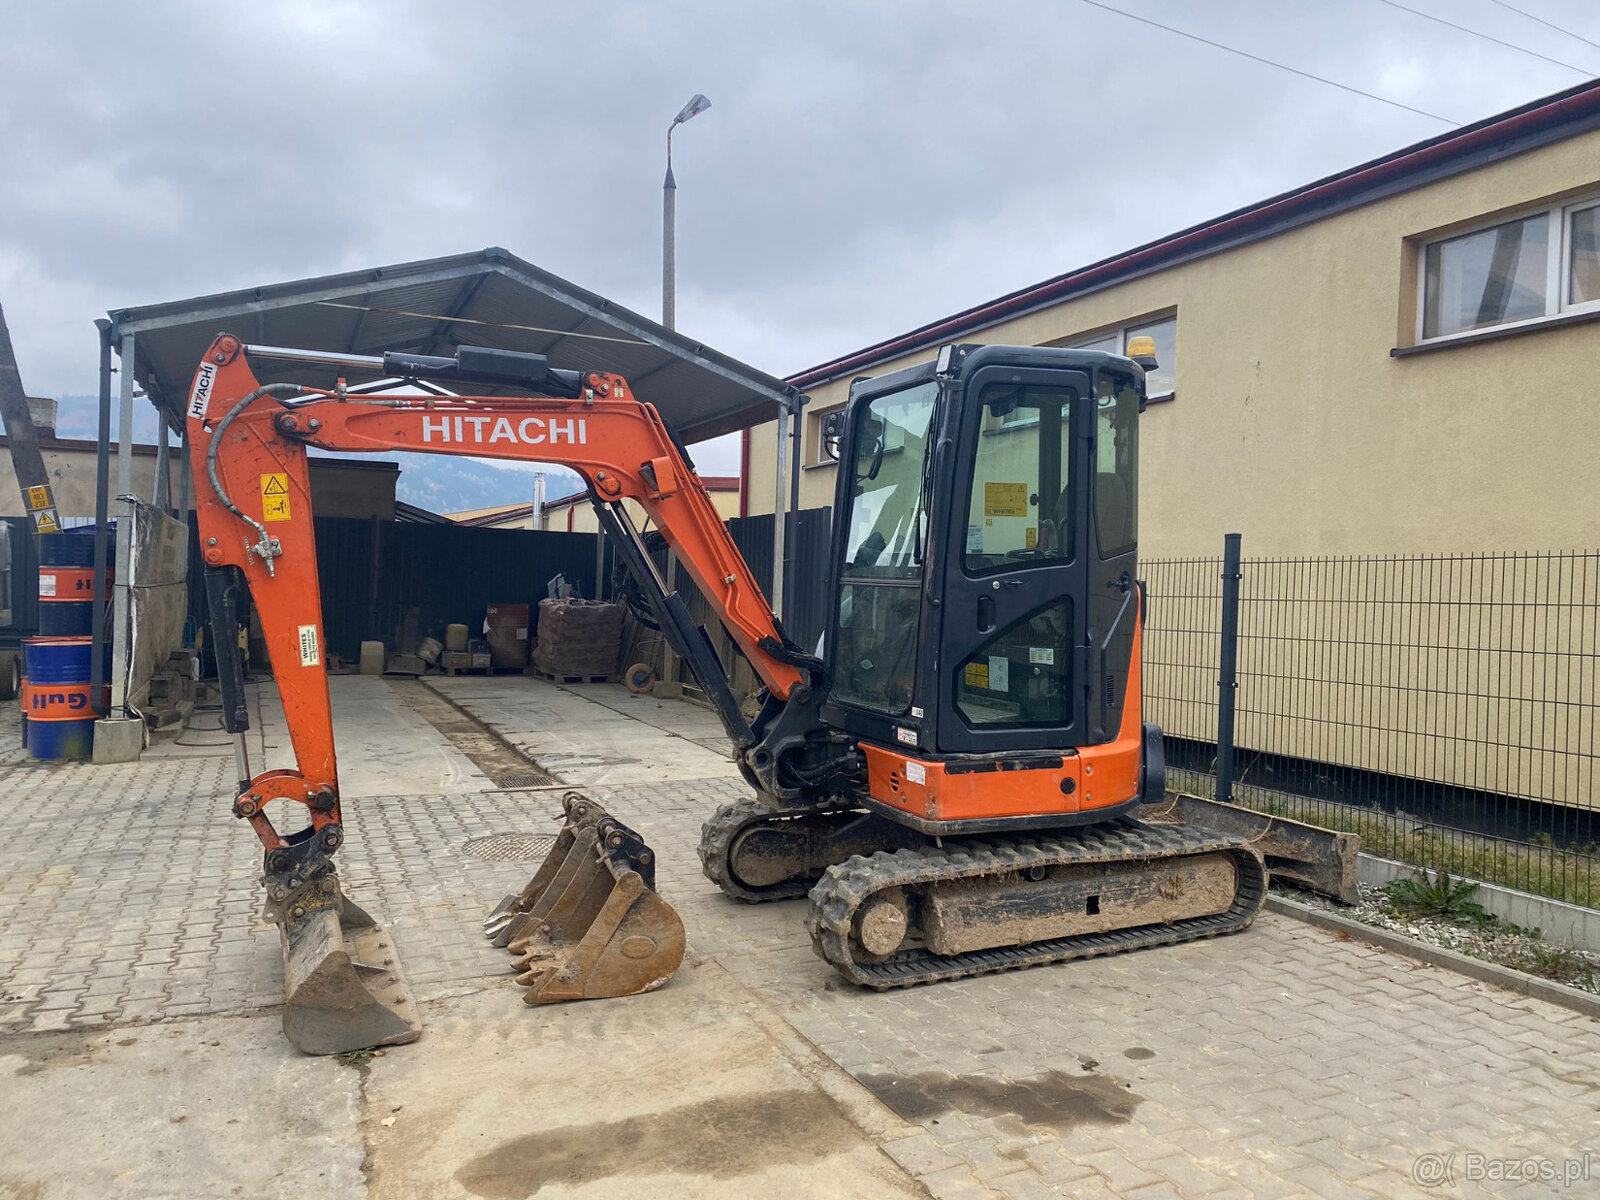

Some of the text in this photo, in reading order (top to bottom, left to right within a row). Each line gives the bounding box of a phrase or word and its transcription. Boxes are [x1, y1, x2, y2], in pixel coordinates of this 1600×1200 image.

[192, 365, 213, 416] HITACHI
[422, 415, 587, 445] HITACHI
[32, 693, 87, 710] Gulf
